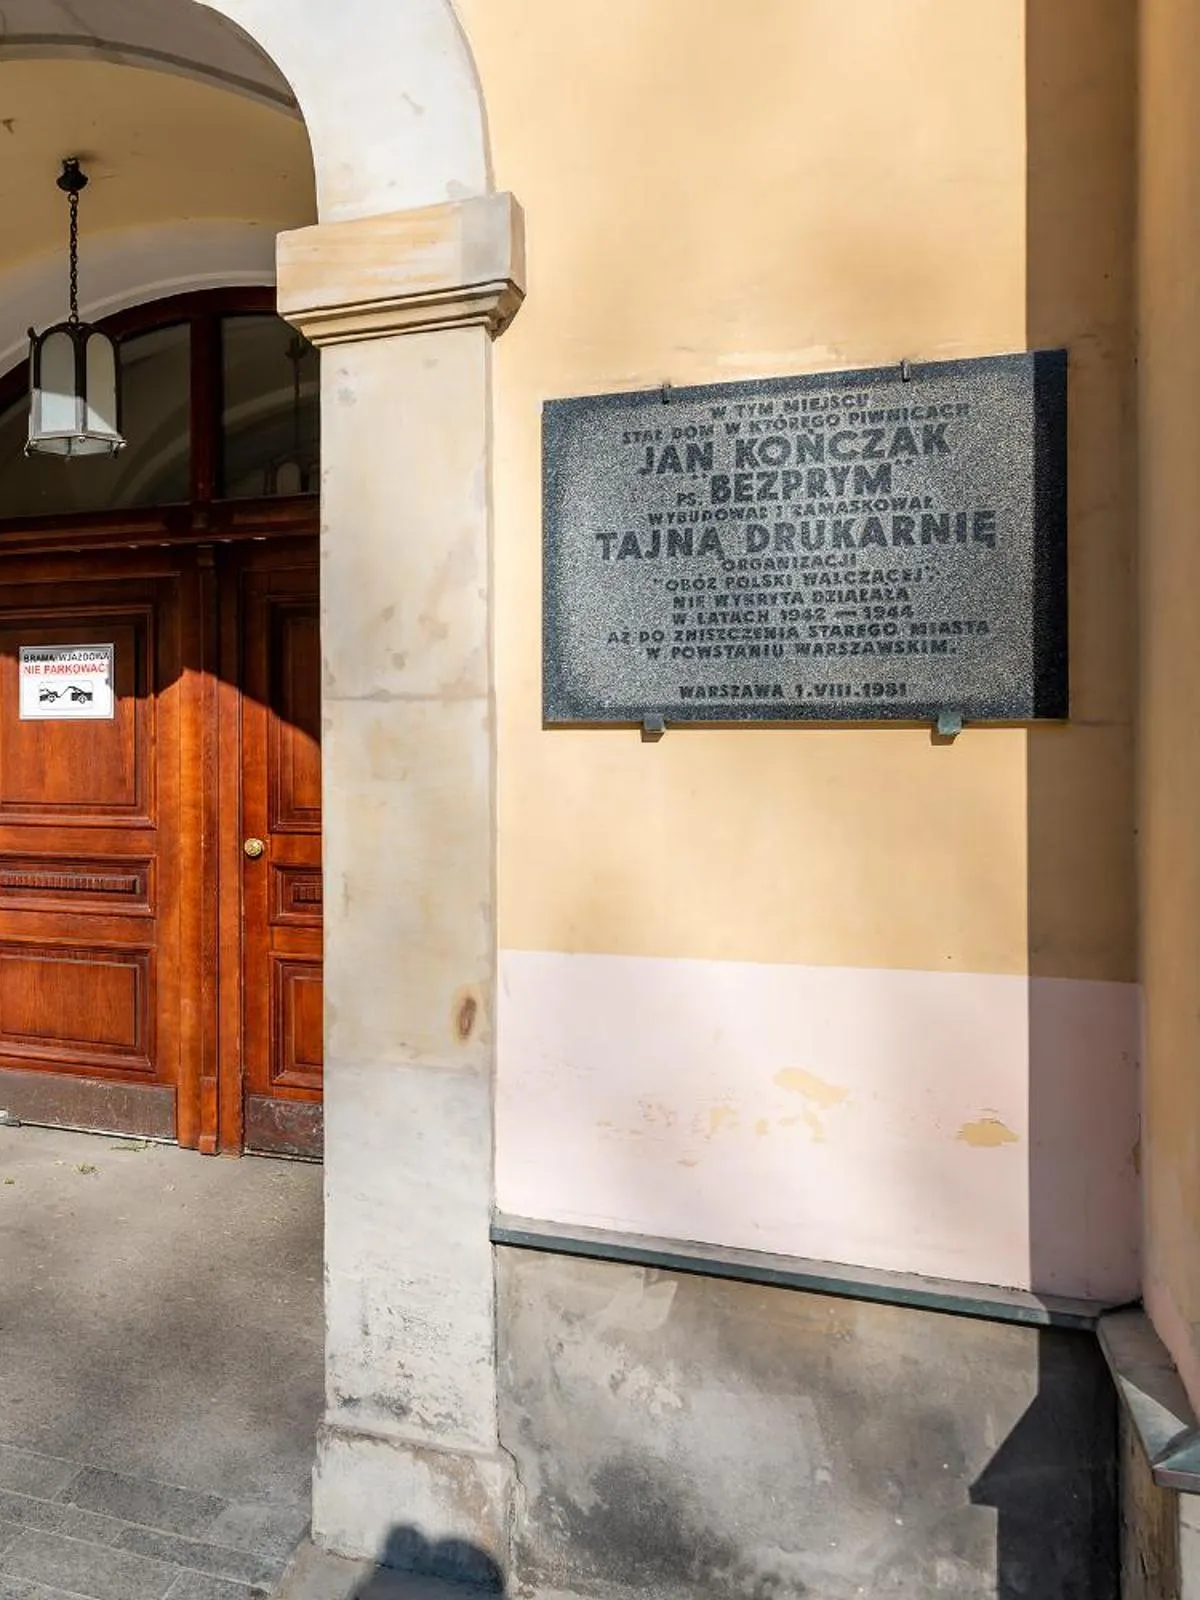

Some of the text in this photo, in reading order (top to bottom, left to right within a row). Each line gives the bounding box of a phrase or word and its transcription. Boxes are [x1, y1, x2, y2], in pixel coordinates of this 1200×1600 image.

[711, 393, 869, 420] W TYM MIEJSCU
[672, 424, 714, 440] DOM
[724, 422, 741, 435] W
[750, 413, 840, 434] KTÓREGO
[849, 402, 970, 425] PIWNICACH
[638, 423, 951, 475] JAN KOŃCZAK
[648, 506, 767, 525] WYBUDOWAŁ
[596, 510, 996, 563] TAJNĄ DRUKARNIĘ
[722, 553, 856, 572] ORGANIZACJI
[726, 574, 792, 589] POLSKI
[673, 595, 705, 609] NIE
[714, 591, 803, 607] WYKRYTA
[673, 613, 686, 625] W
[697, 609, 769, 624] LATACH
[781, 608, 826, 622] 1942
[864, 604, 913, 620] 1944
[640, 630, 664, 642] DO
[674, 626, 800, 642] ZNISZCZENIA
[808, 622, 897, 637] STAREGO
[910, 621, 989, 635] MIASTA
[647, 648, 661, 660] W
[672, 644, 784, 660] POWSTANIU
[24, 665, 41, 674] NIE
[680, 684, 783, 698] WARSZAWA
